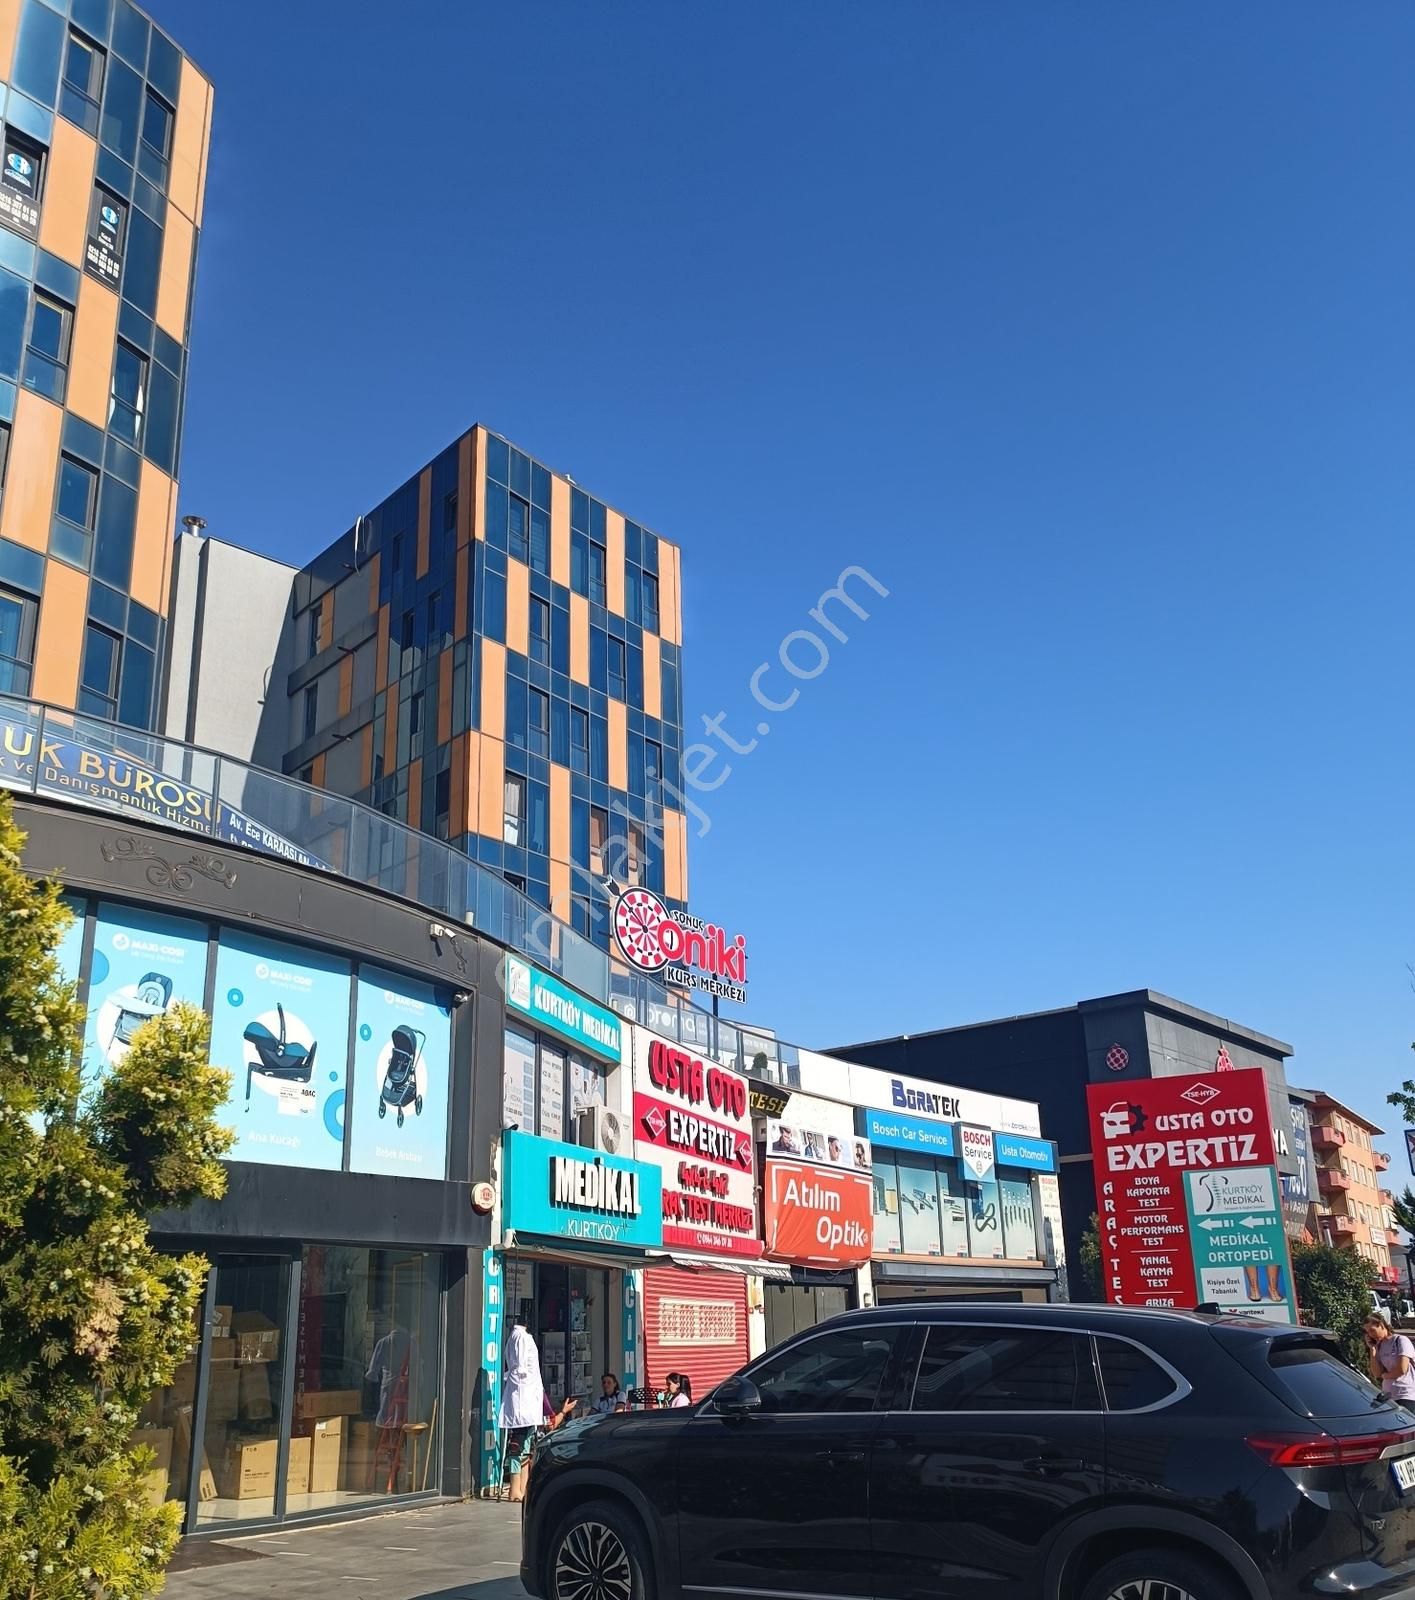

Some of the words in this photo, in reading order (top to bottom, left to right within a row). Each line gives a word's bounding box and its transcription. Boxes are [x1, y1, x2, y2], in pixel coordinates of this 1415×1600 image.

[14, 760, 34, 774] ve
[45, 767, 162, 815] Danışmanlık
[229, 812, 243, 831] Av.
[246, 822, 261, 842] Ece
[667, 967, 698, 988] KURS
[701, 977, 746, 1003] MERKEZİ
[534, 984, 581, 1030] KURTKÖY
[582, 1010, 620, 1052] MEDİKAL
[649, 1040, 704, 1106] USTA
[707, 1067, 746, 1119] OTO
[1155, 1111, 1205, 1131] USTA
[1210, 1107, 1254, 1127] OTO
[669, 1108, 737, 1161] EXPERTİZ
[873, 1120, 900, 1137] Bosch
[902, 1125, 917, 1141] Car
[919, 1129, 948, 1146] Service
[963, 1130, 991, 1147] BOSCH
[964, 1145, 993, 1161] Service
[1001, 1144, 1018, 1157] Usta
[1019, 1147, 1048, 1162] Otomotiv
[1107, 1133, 1259, 1172] EXPERTİZ
[552, 1156, 642, 1214] MEDİKAL
[1134, 1176, 1160, 1186] BOYA
[783, 1179, 840, 1212] Atılım
[1126, 1186, 1170, 1197] KAPORTA
[1222, 1185, 1263, 1196] KURTKÖY
[1138, 1198, 1160, 1207] TEST
[1223, 1194, 1265, 1206] MEDİKAL
[1102, 1181, 1118, 1250] ARAÇ
[1134, 1214, 1168, 1224] MOTOR
[567, 1218, 621, 1241] KURTKÖY
[816, 1216, 865, 1250] Optik
[1120, 1224, 1185, 1236] PERFORMANS
[1142, 1237, 1164, 1246] TEST
[1209, 1232, 1268, 1247] MEDİKAL
[1140, 1256, 1172, 1266] YANAL
[1208, 1248, 1274, 1263] ORTOPEDİ
[1140, 1267, 1173, 1277] KAYMA
[1147, 1279, 1169, 1288] TEST
[1207, 1278, 1225, 1287] Kişiye
[1226, 1277, 1240, 1286] Özel
[1211, 1287, 1238, 1295] Tabanlık
